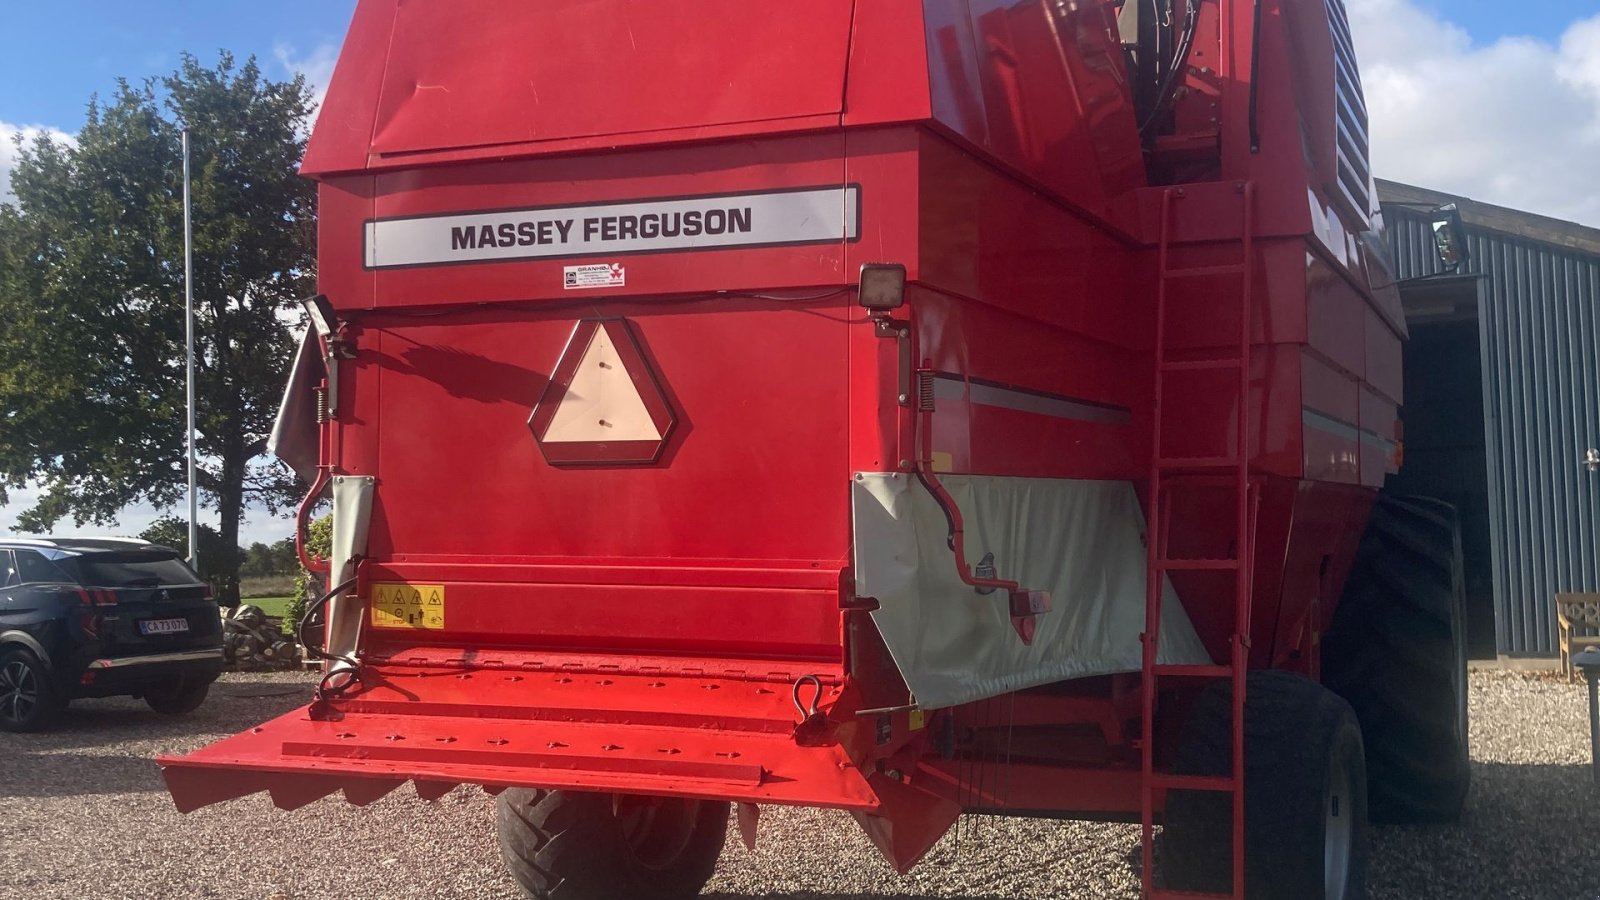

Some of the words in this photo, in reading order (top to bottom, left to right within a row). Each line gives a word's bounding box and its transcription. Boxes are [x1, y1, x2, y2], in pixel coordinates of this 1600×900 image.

[451, 219, 574, 250] MASSEY
[583, 207, 752, 242] FERGUSON
[147, 622, 159, 632] CA
[159, 621, 170, 630] 73
